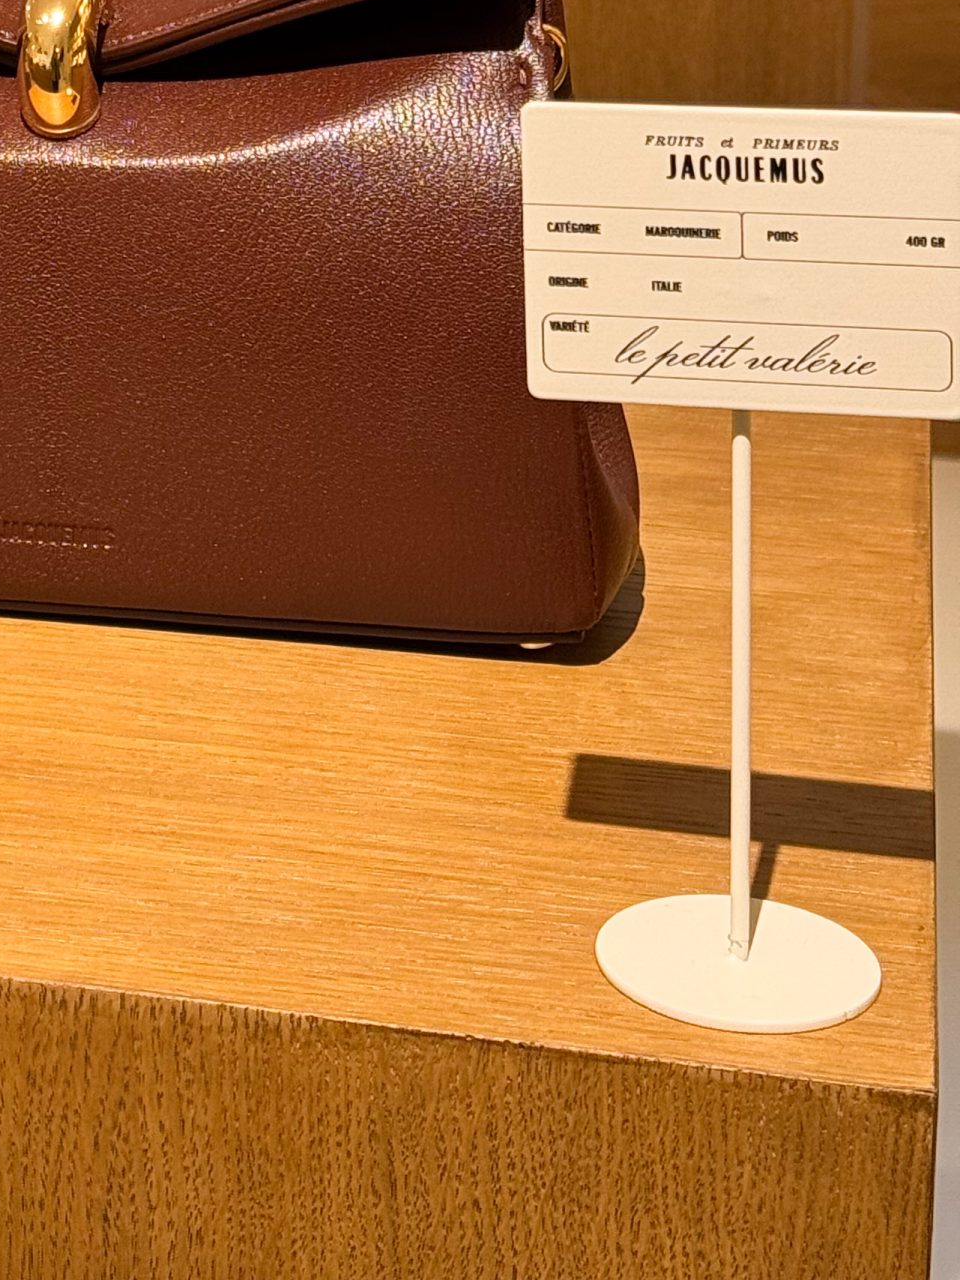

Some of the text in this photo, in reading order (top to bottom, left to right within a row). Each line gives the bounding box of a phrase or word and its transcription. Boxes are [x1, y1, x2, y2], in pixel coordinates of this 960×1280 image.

[644, 135, 840, 151] FRUITS et PRIMEURS
[666, 153, 825, 185] JACQUEMUS
[547, 221, 722, 240] CATÉGORIE MAROQUINERIE
[767, 231, 946, 248] POIDS 400 GR
[548, 276, 683, 293] ORIGINE ITALIE
[549, 319, 590, 333] VARIÉTÉ
[614, 325, 878, 384] le petit valérie
